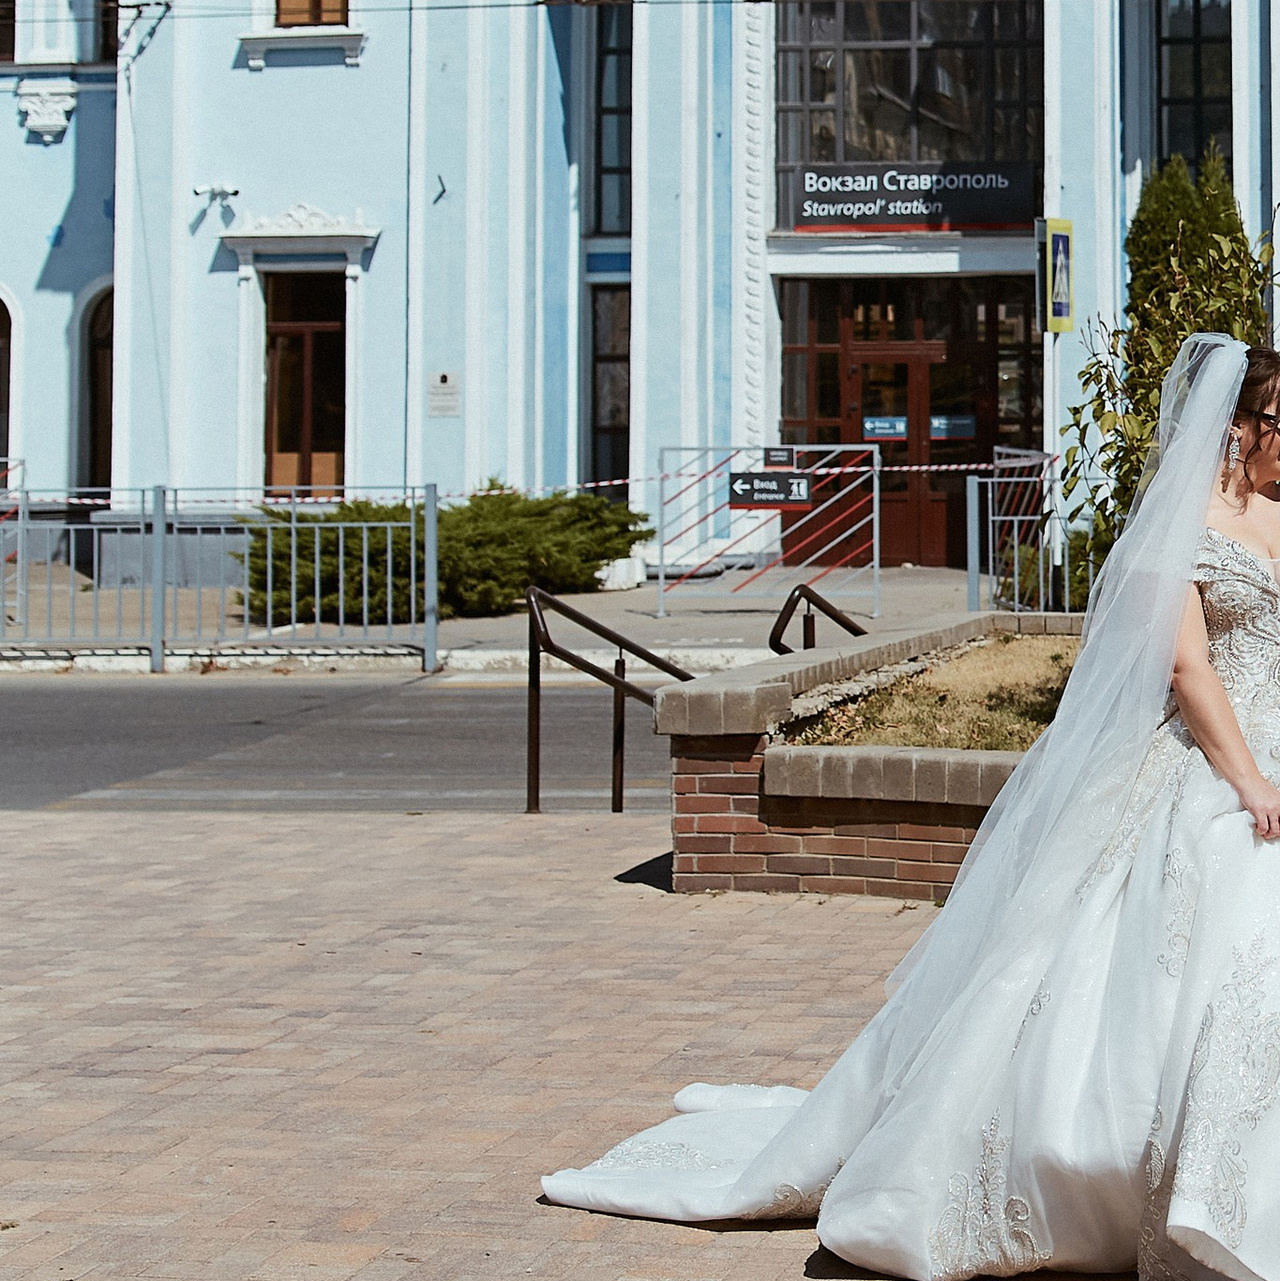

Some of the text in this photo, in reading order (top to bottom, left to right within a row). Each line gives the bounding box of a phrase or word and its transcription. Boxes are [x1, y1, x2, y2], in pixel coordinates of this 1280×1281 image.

[804, 170, 1009, 194] Вокзал Ставрополь
[887, 198, 943, 215] station
[753, 479, 778, 491] Вход
[753, 492, 785, 501] Entrance
